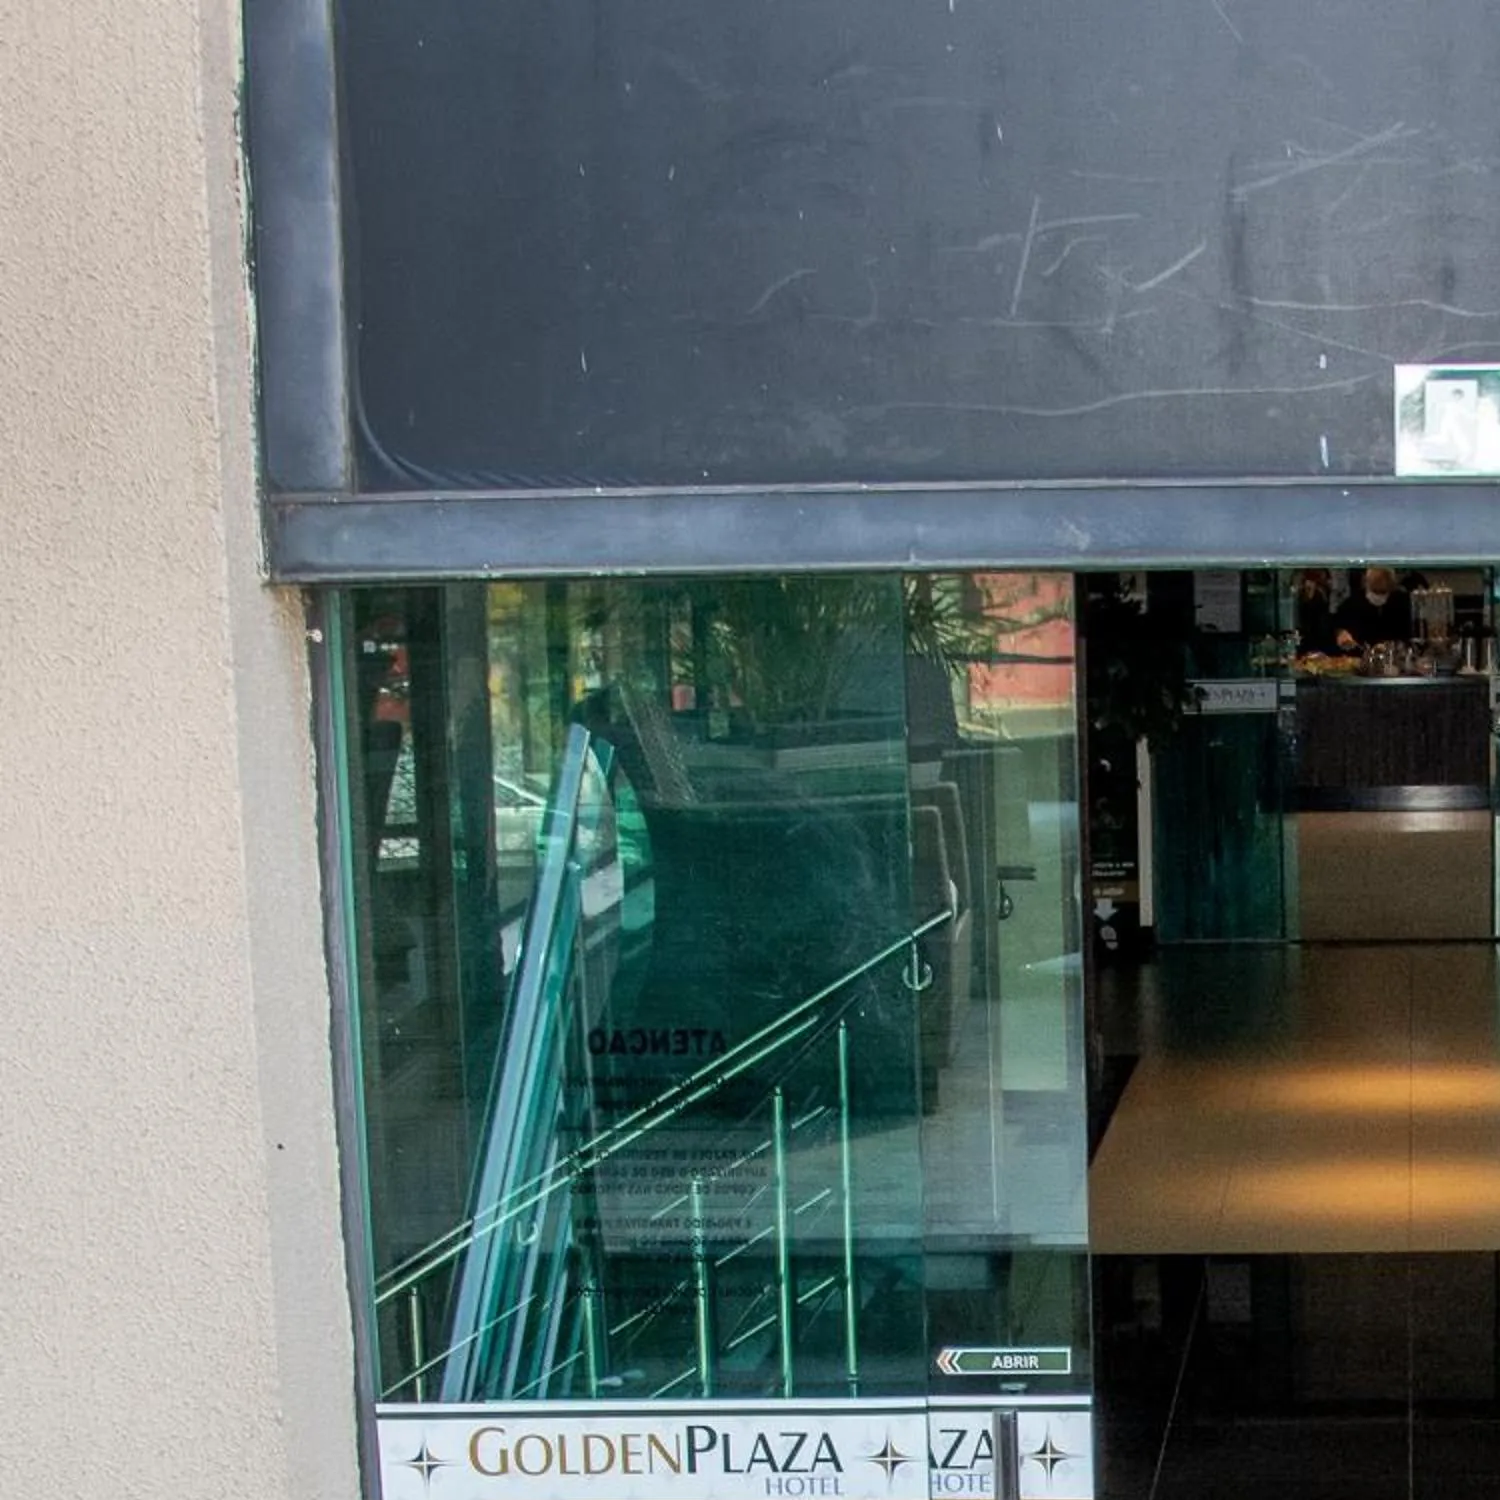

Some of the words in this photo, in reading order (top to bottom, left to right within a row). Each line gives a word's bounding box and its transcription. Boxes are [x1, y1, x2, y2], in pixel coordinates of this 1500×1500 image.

[991, 1355, 1039, 1369] ABRIR
[929, 1429, 993, 1469] ZA
[765, 1476, 845, 1497] HOTEL
[930, 1472, 993, 1493] HOTE
